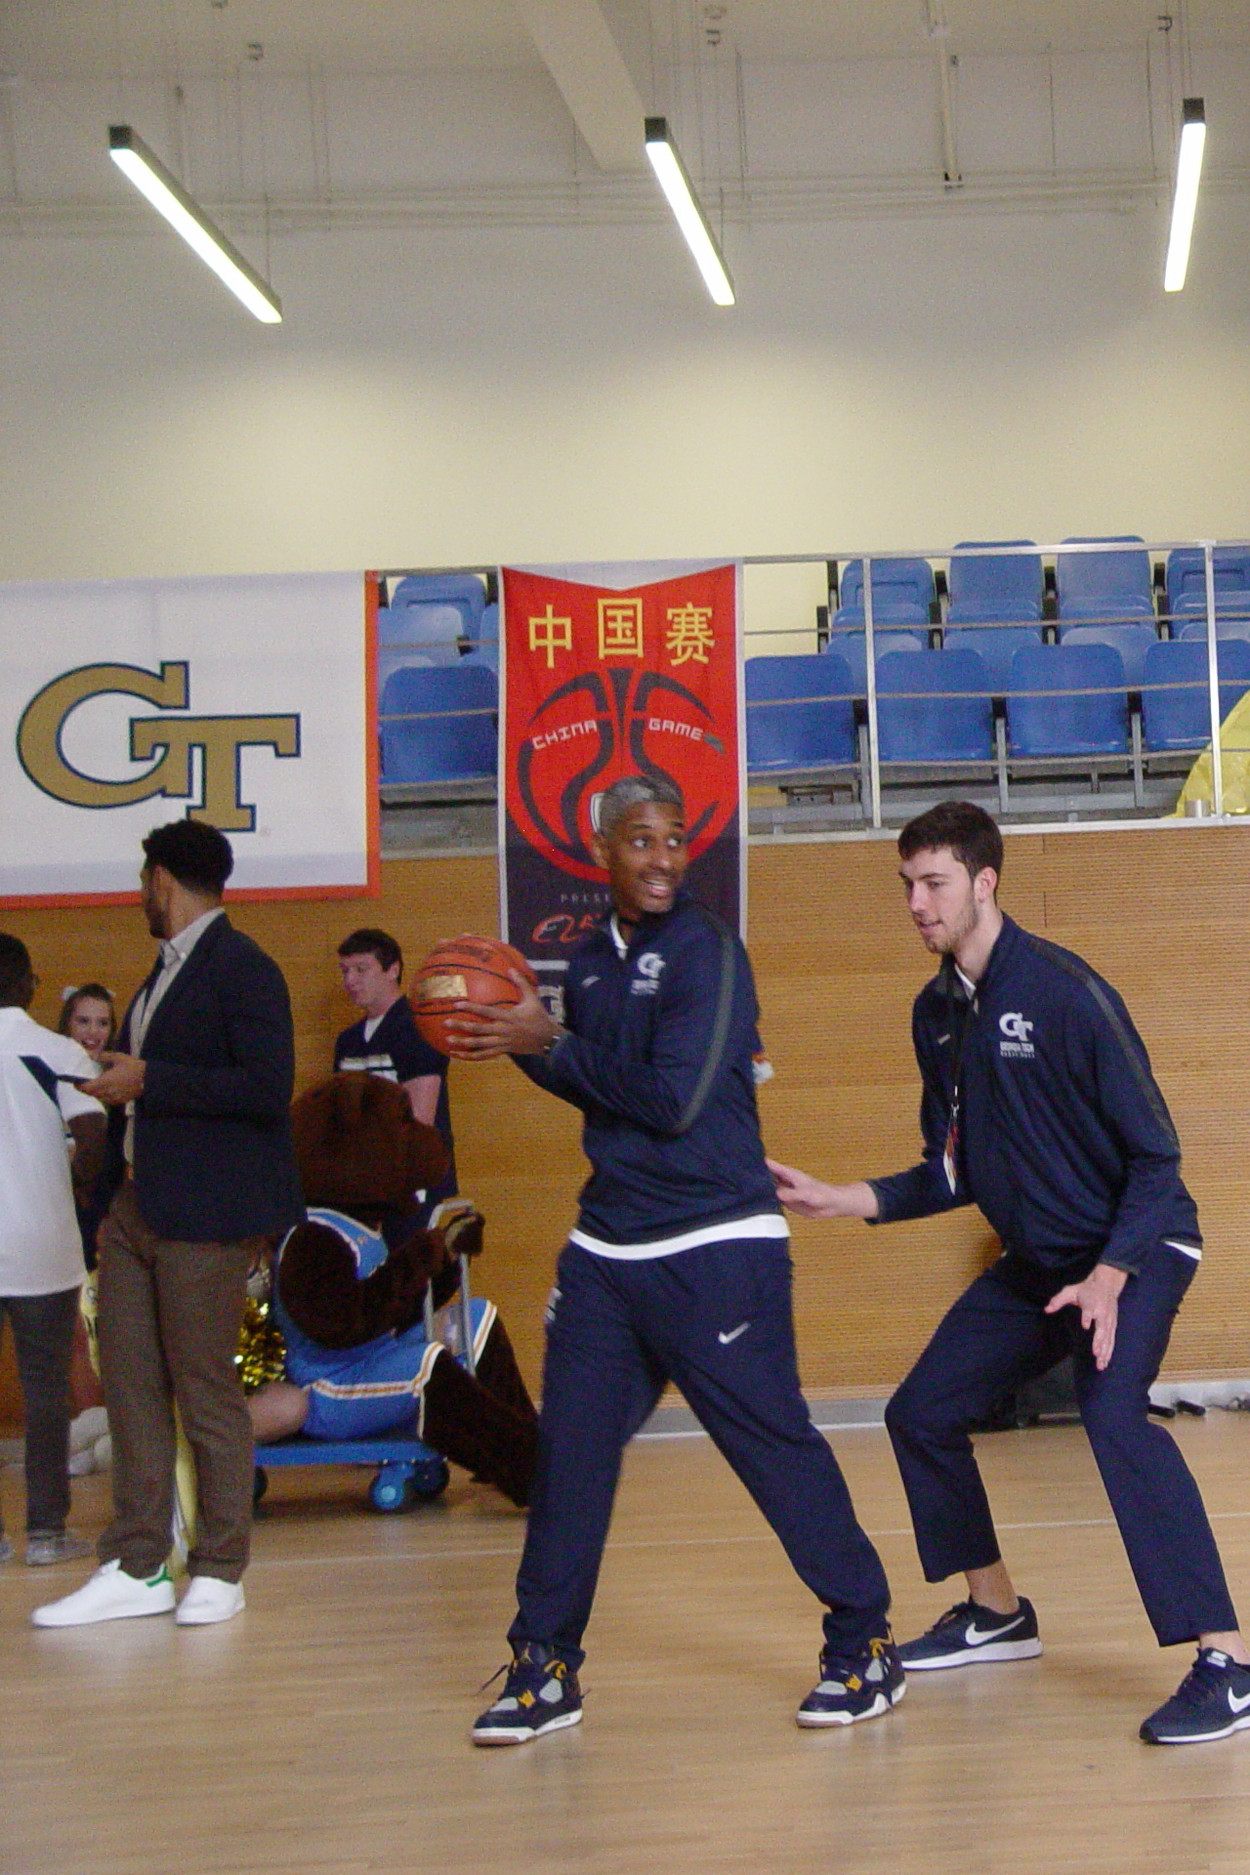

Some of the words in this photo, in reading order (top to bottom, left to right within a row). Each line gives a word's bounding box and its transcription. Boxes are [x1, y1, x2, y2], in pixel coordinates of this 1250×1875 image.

[528, 597, 716, 669] 中国赛
[16, 660, 301, 832] GT
[532, 719, 598, 750] CHINA
[648, 717, 704, 741] GAME
